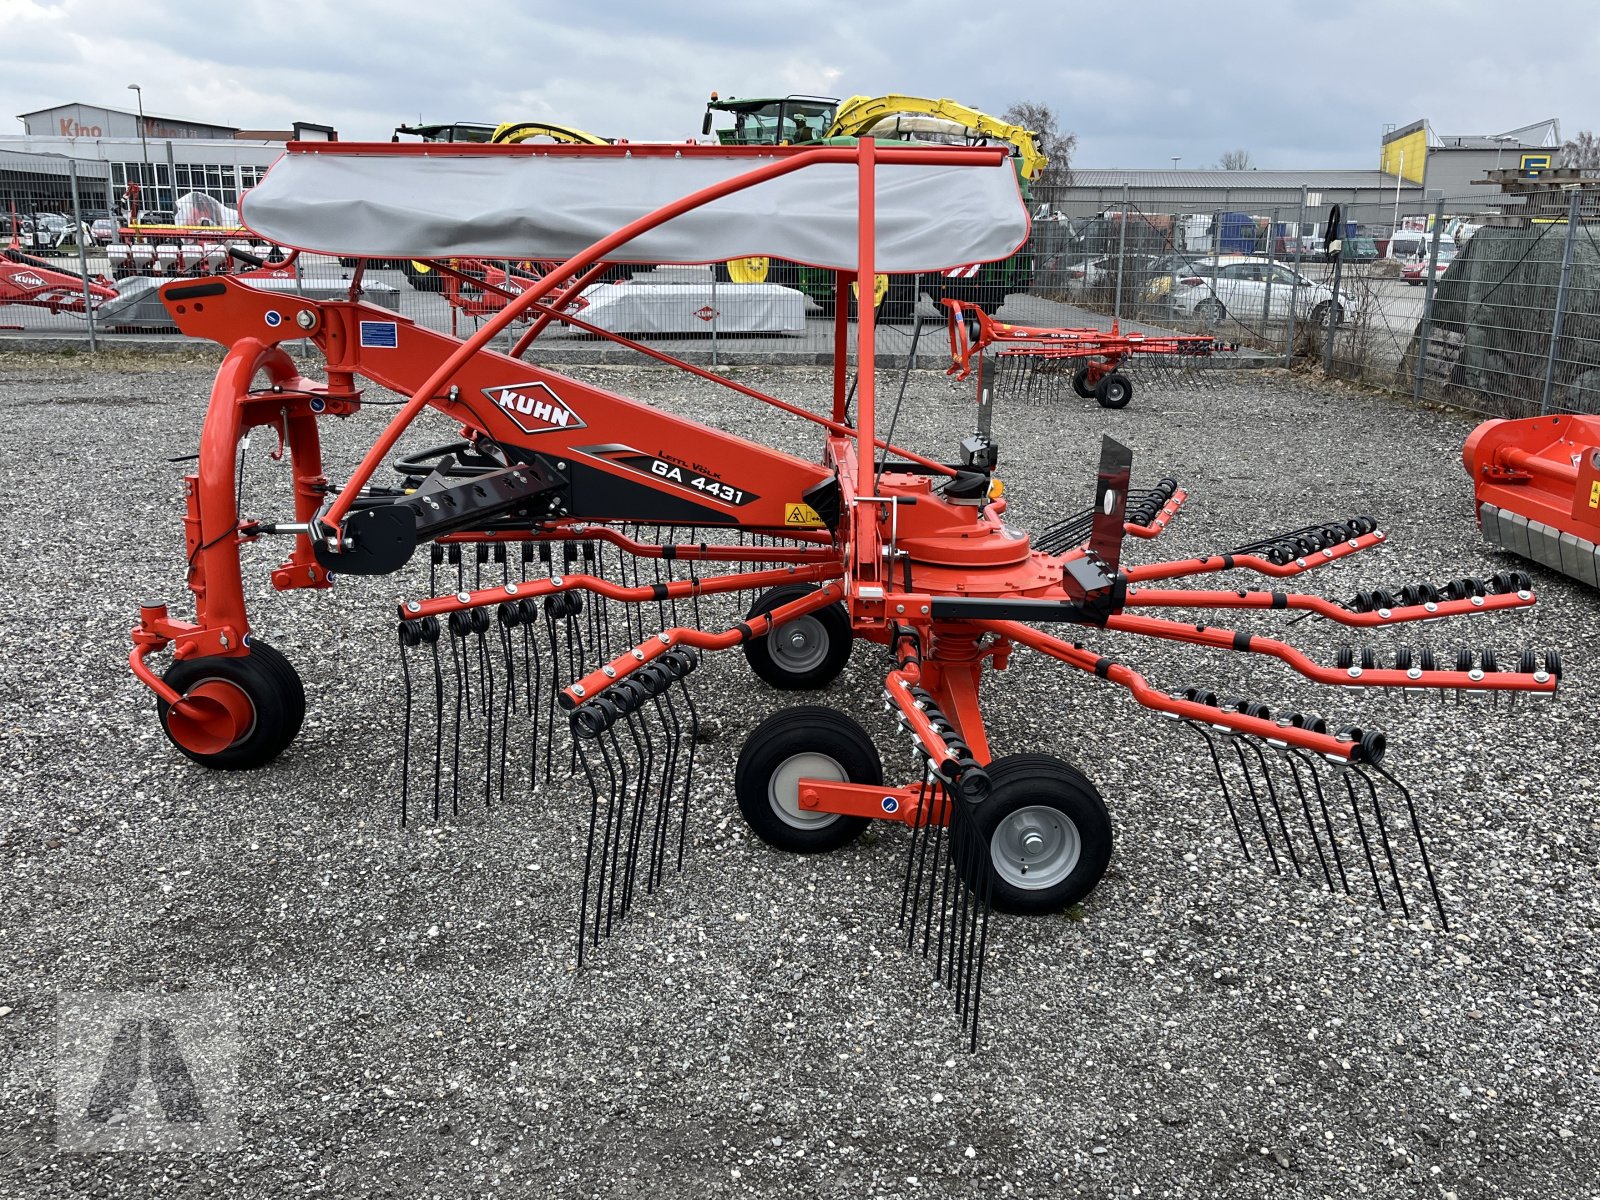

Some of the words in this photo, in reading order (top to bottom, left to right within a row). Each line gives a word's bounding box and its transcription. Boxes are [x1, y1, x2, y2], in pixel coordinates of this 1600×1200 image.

[15, 275, 42, 285] KUHN
[499, 389, 570, 428] KUHN
[651, 460, 682, 482] GA
[691, 477, 743, 504] 4431
